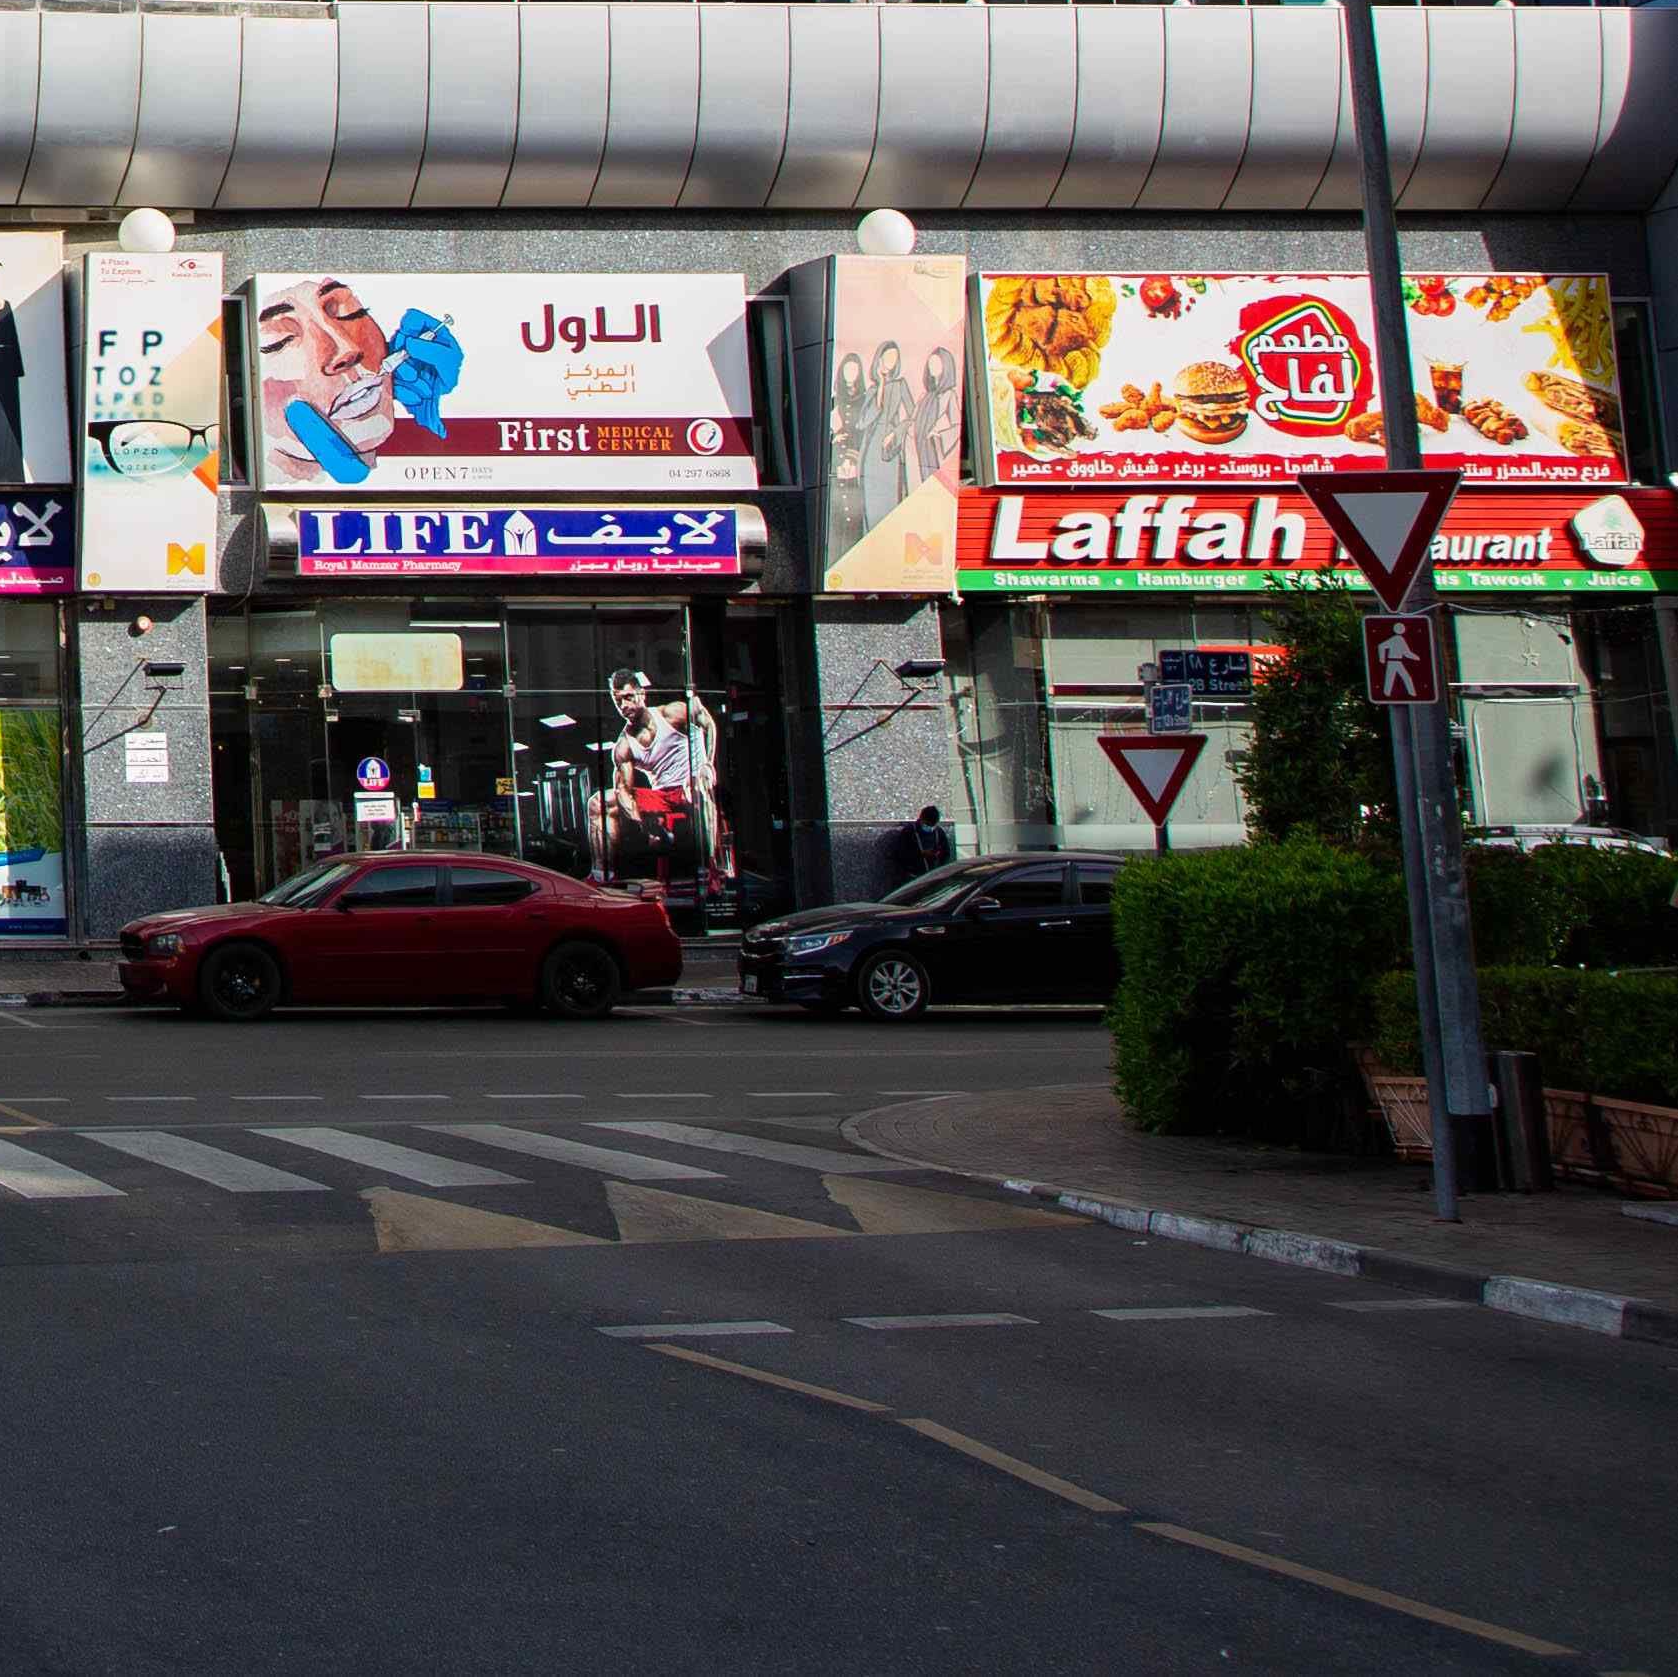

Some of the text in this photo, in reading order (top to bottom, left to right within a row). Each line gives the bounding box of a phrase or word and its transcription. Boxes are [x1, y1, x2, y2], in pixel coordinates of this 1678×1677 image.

[520, 303, 663, 354] الاول
[99, 330, 163, 357] F P
[1252, 324, 1349, 364] مطعم
[563, 363, 636, 384] المركز
[567, 380, 636, 401] الطبي
[497, 419, 591, 451] First
[597, 426, 674, 438] MEDICAL
[597, 439, 672, 451] CENTER
[404, 466, 457, 480] OPEN
[669, 469, 731, 479] 04 297 6868
[1012, 460, 1051, 478] عصير
[1066, 460, 1114, 477] طاووق
[1118, 459, 1160, 477] شيش
[1173, 459, 1205, 478] برغر
[1220, 460, 1270, 476] بروستد
[1460, 463, 1492, 476] سنت
[1581, 464, 1610, 481] فرع
[311, 512, 493, 554] LIFE
[547, 513, 725, 555] لايف
[989, 496, 1306, 560] Laffah
[1584, 532, 1642, 550] Laffah
[314, 561, 462, 572] Royal Mamzar Pharmacy
[570, 560, 722, 572] صيدلية رويال ممزر
[994, 572, 1100, 587] Shawarma
[1137, 572, 1247, 588] Hamburger
[1469, 572, 1545, 586] Tawook
[1588, 573, 1643, 586] Juice
[1209, 655, 1247, 675] شارع
